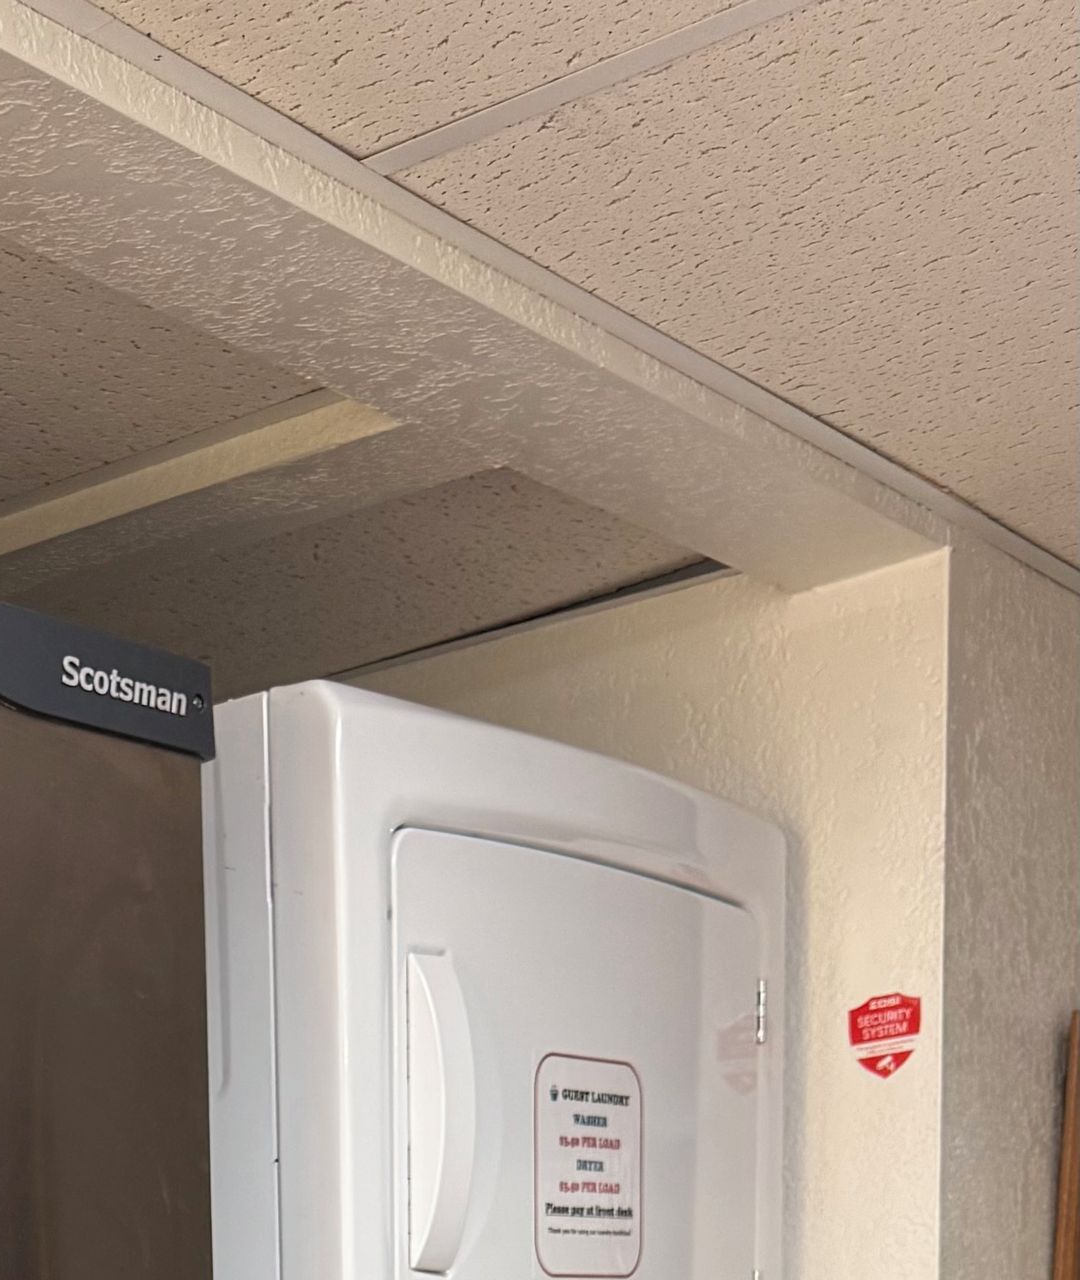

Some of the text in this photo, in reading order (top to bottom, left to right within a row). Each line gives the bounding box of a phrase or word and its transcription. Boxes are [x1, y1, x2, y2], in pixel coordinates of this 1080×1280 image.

[61, 655, 188, 716] Scotsman
[856, 1007, 913, 1029] SECURITY
[861, 1021, 909, 1041] SYSTEM
[561, 1088, 630, 1107] GUEST LAUNDRY
[572, 1113, 608, 1128] WASHER
[581, 1136, 597, 1149] PER
[575, 1159, 604, 1172] DRYER
[581, 1181, 597, 1193] PER
[545, 1202, 633, 1218] Please pay at front desk
